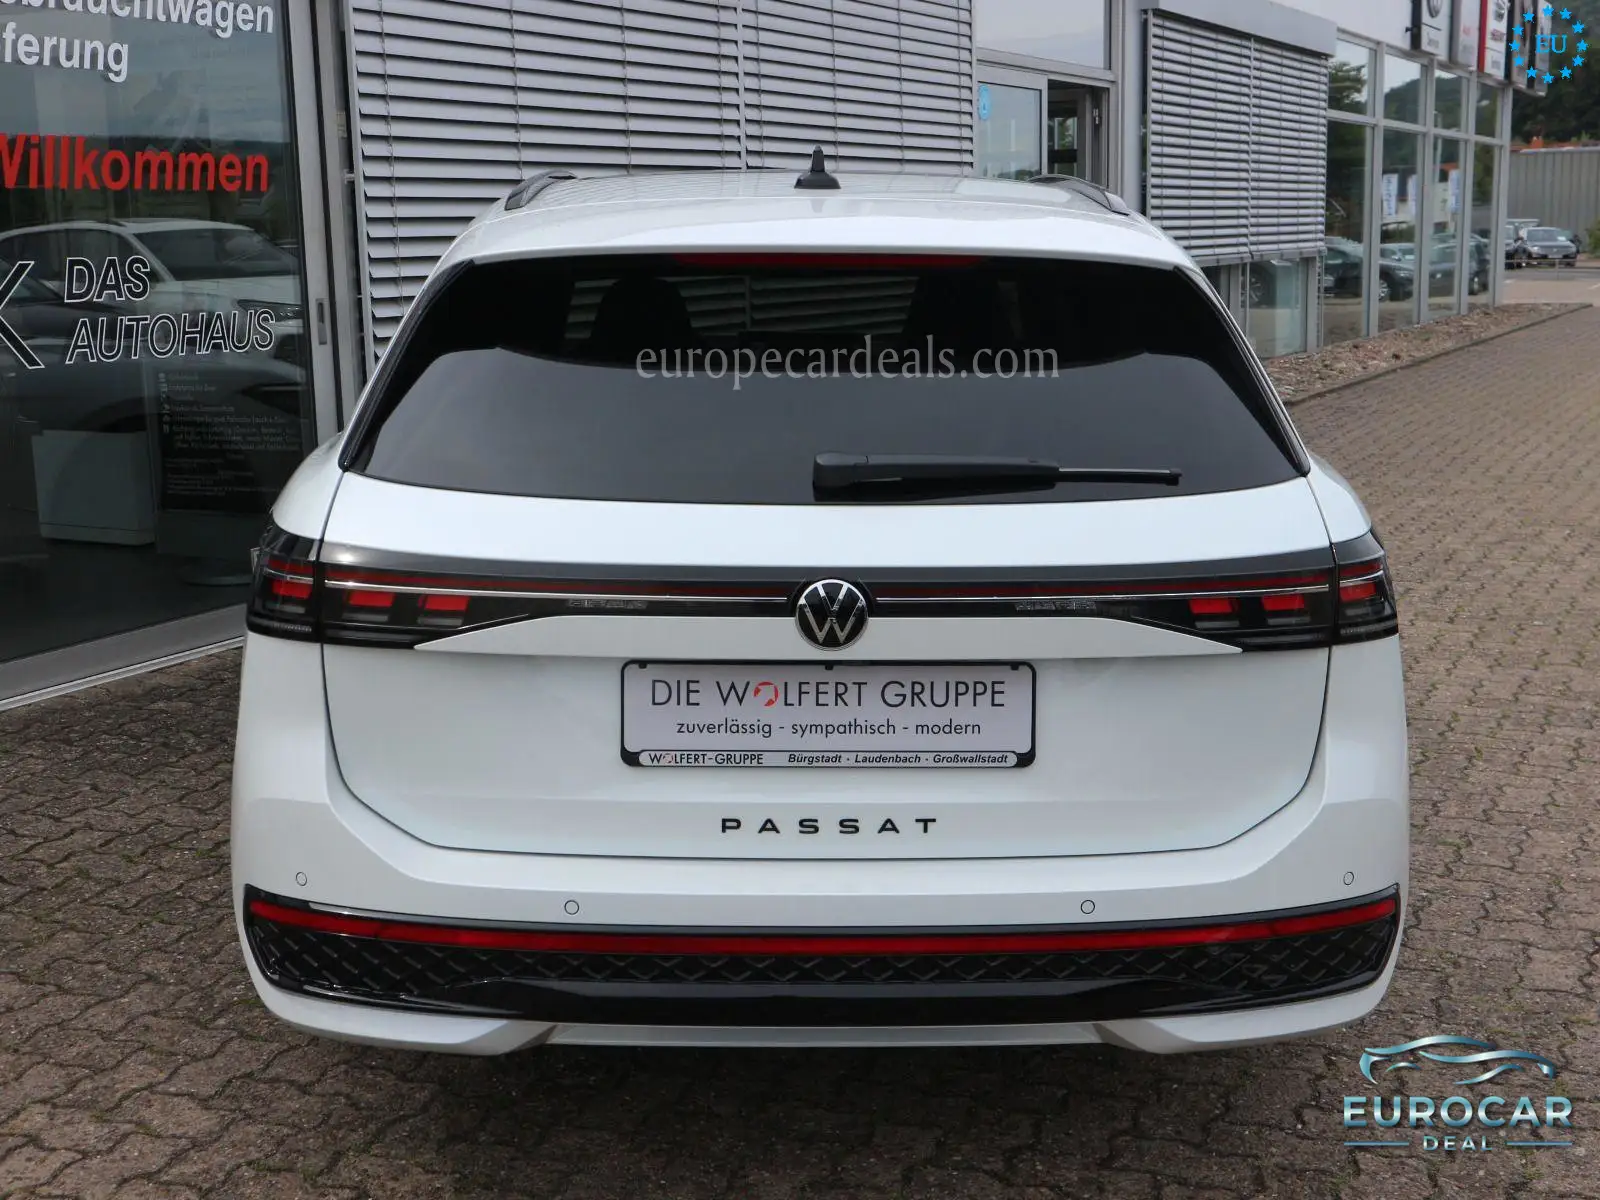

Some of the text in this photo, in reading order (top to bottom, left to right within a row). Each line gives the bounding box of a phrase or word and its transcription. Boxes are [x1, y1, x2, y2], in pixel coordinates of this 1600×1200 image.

[0, 0, 274, 39] uchtwagen
[64, 255, 151, 303] DAS
[65, 308, 276, 365] AUTOHAUS
[651, 678, 1006, 708] DIE WOLFERT GRUPPE
[676, 716, 772, 738] zuverlässig
[791, 717, 896, 739] sympathisch
[915, 717, 981, 735] modern
[648, 753, 1008, 765] WOLFERT-GRUPPE Bürgstadt Laudenbach Großwallstadt
[721, 818, 937, 835] PASSAT
